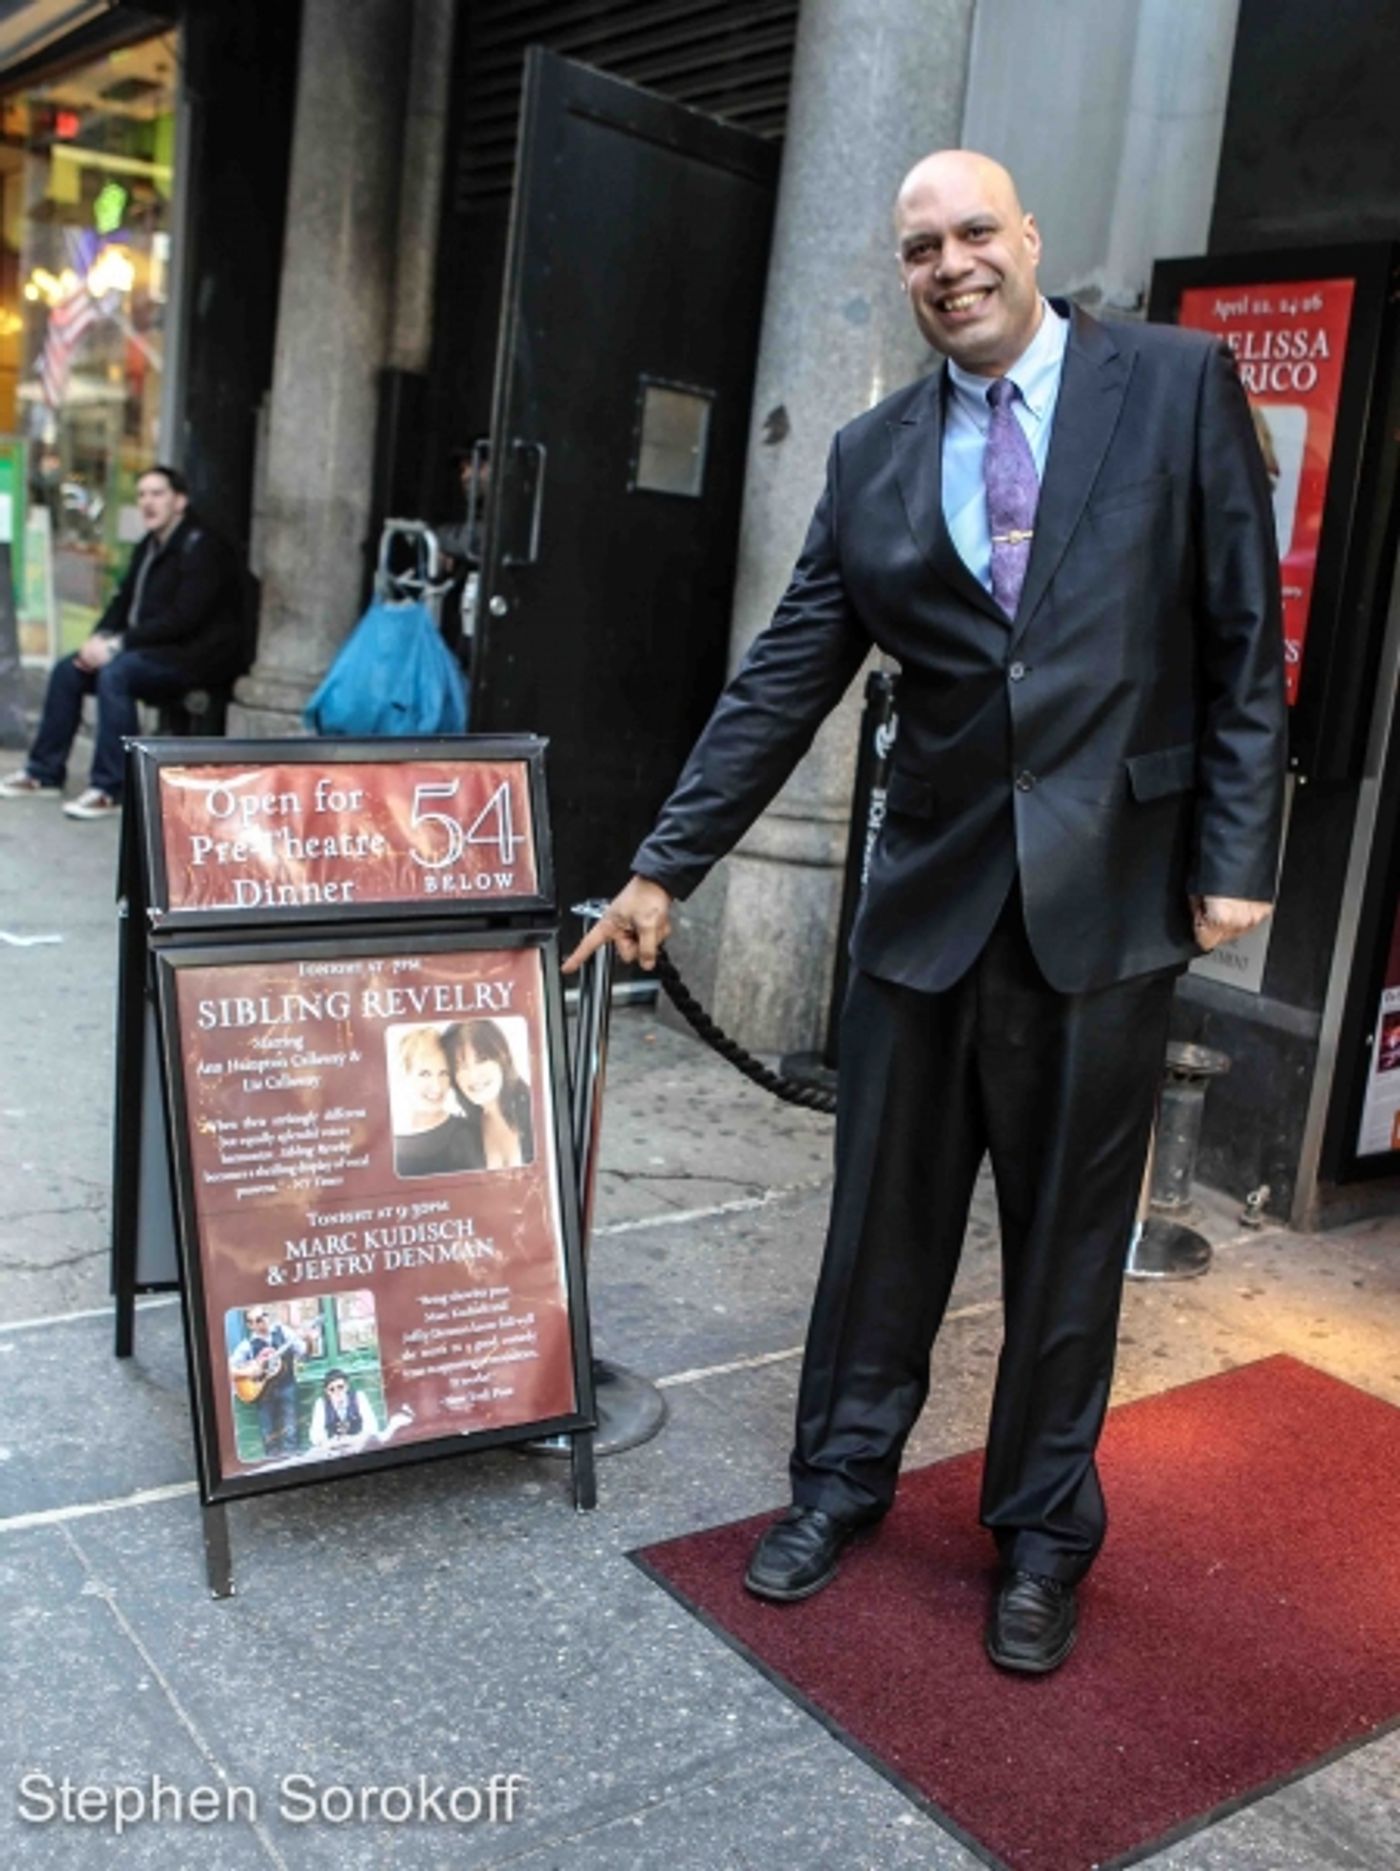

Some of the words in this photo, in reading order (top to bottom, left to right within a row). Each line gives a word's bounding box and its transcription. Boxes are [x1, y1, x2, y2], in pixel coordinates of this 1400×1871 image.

[1213, 293, 1249, 323] April
[1216, 328, 1330, 360] ELISSA
[1239, 361, 1318, 394] RICO
[204, 784, 301, 827] Open
[314, 779, 364, 815] for
[409, 776, 526, 869] 54
[233, 878, 356, 908] Dinner
[424, 872, 515, 894] BELOW
[197, 991, 352, 1030] SIBLING
[361, 981, 516, 1020] REVELRY
[284, 1231, 358, 1262] MARC
[362, 1218, 475, 1252] KUDISCH
[265, 1263, 286, 1286] &
[291, 1251, 378, 1285] JEFFRY
[384, 1237, 496, 1271] DENMAN
